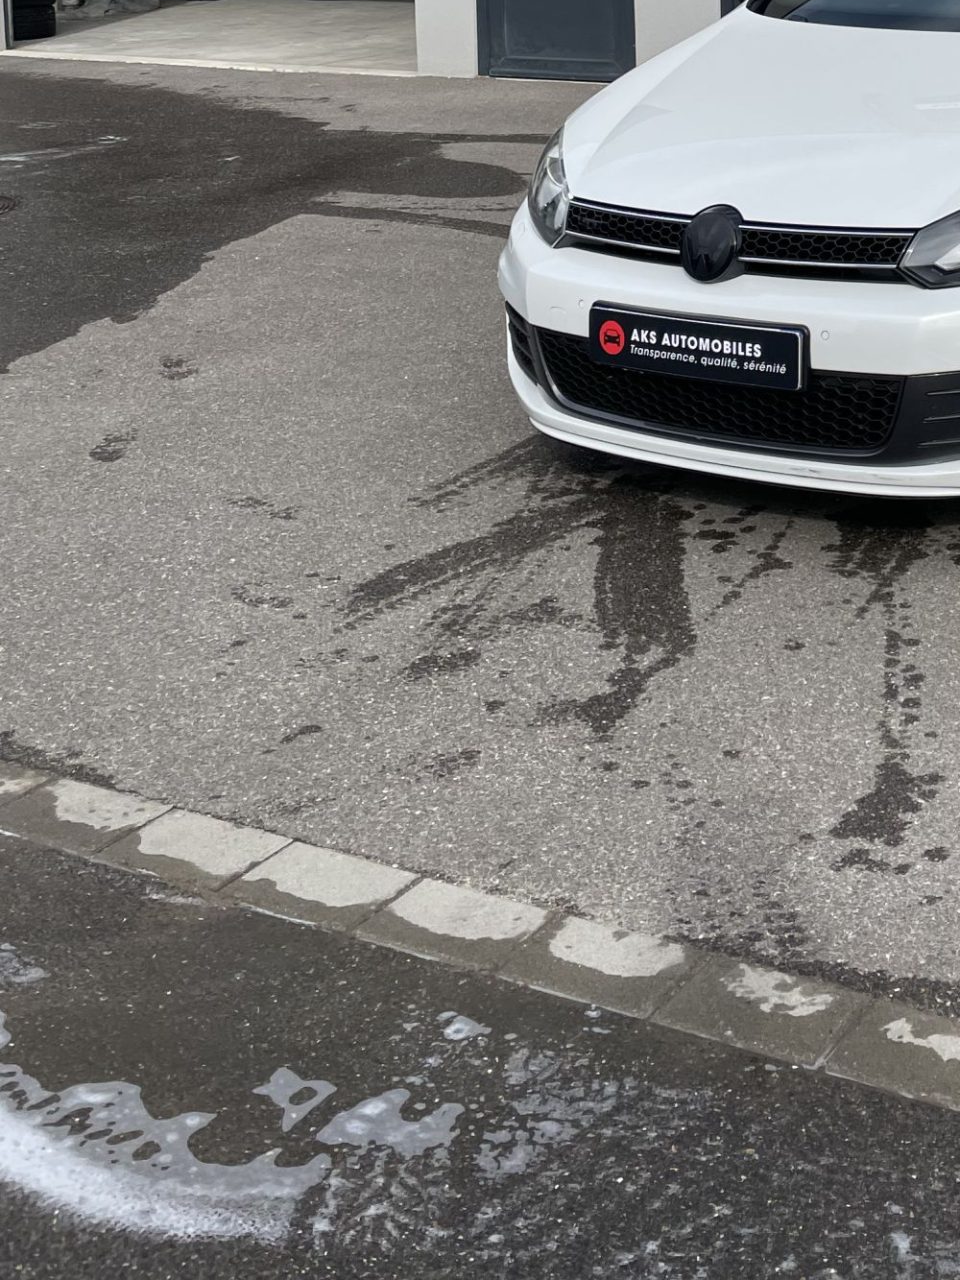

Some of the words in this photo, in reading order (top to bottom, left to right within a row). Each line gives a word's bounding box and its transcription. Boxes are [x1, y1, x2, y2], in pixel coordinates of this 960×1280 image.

[630, 328, 657, 344] AKS
[661, 333, 762, 358] AUTOMOBILES
[630, 344, 698, 364] Transparence,
[700, 355, 740, 370] qualité,
[743, 359, 787, 375] sérénité
